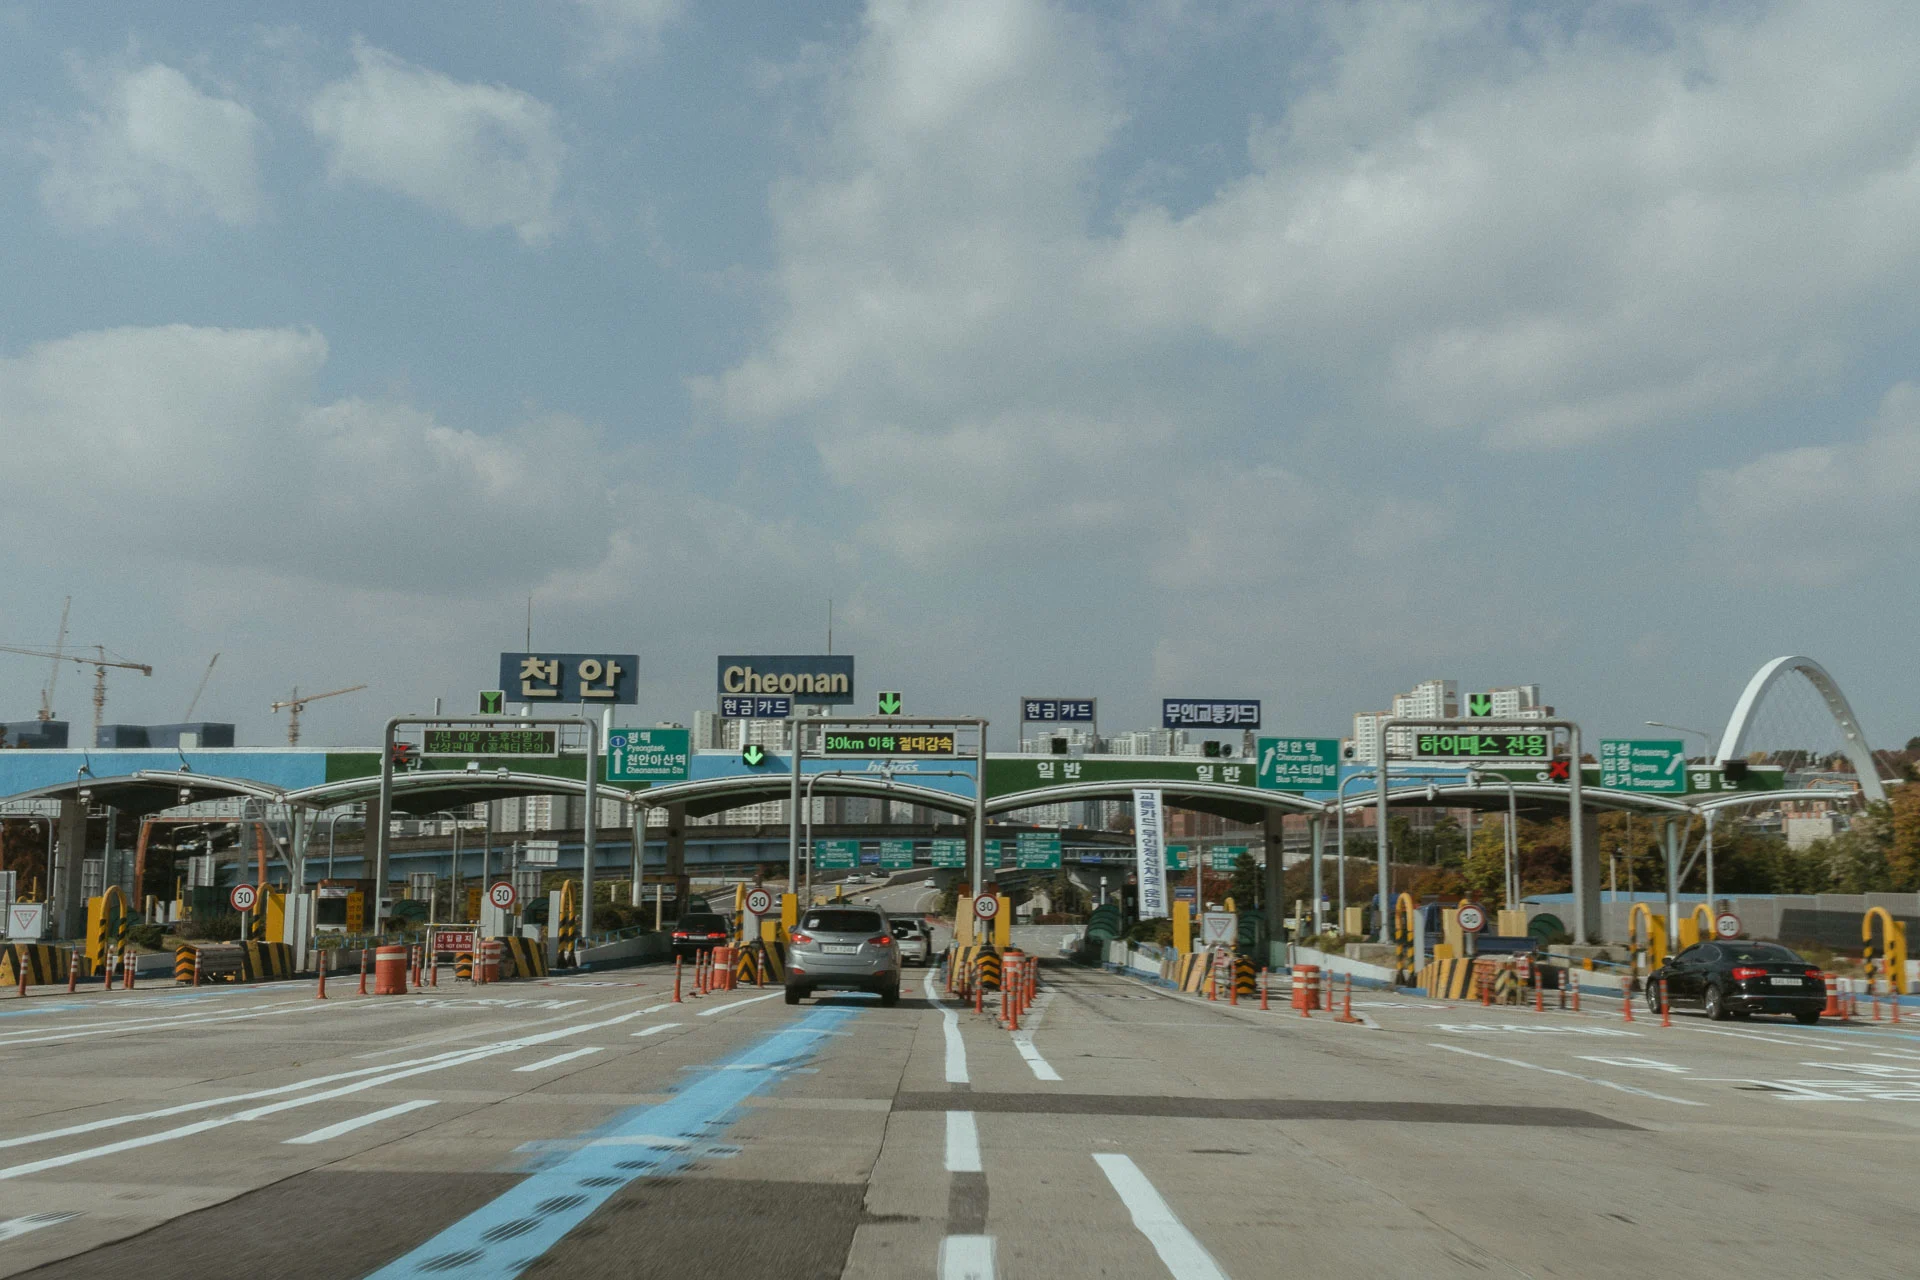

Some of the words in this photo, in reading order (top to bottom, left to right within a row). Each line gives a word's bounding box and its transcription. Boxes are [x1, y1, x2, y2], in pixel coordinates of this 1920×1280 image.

[723, 665, 848, 693] Cheonan
[723, 699, 753, 715] 현금
[758, 700, 788, 714] 카드
[1026, 702, 1056, 719] 현금
[1061, 703, 1091, 718] 카드
[458, 731, 480, 742] 이상
[627, 731, 651, 744] 평택
[826, 736, 865, 750] 30km
[868, 736, 896, 751] 이하
[898, 736, 953, 752] 절대감속
[1276, 740, 1317, 754] 천안역
[1419, 735, 1501, 757] 하이패스
[1505, 735, 1546, 757] 전용
[1602, 742, 1631, 757] 안성
[626, 753, 687, 766] 천안아산역
[1275, 763, 1336, 776] 버스터미널
[1603, 773, 1632, 787] 성거
[237, 891, 251, 904] 30
[495, 889, 510, 902] 30
[751, 896, 766, 907] 30
[979, 901, 994, 912] 30
